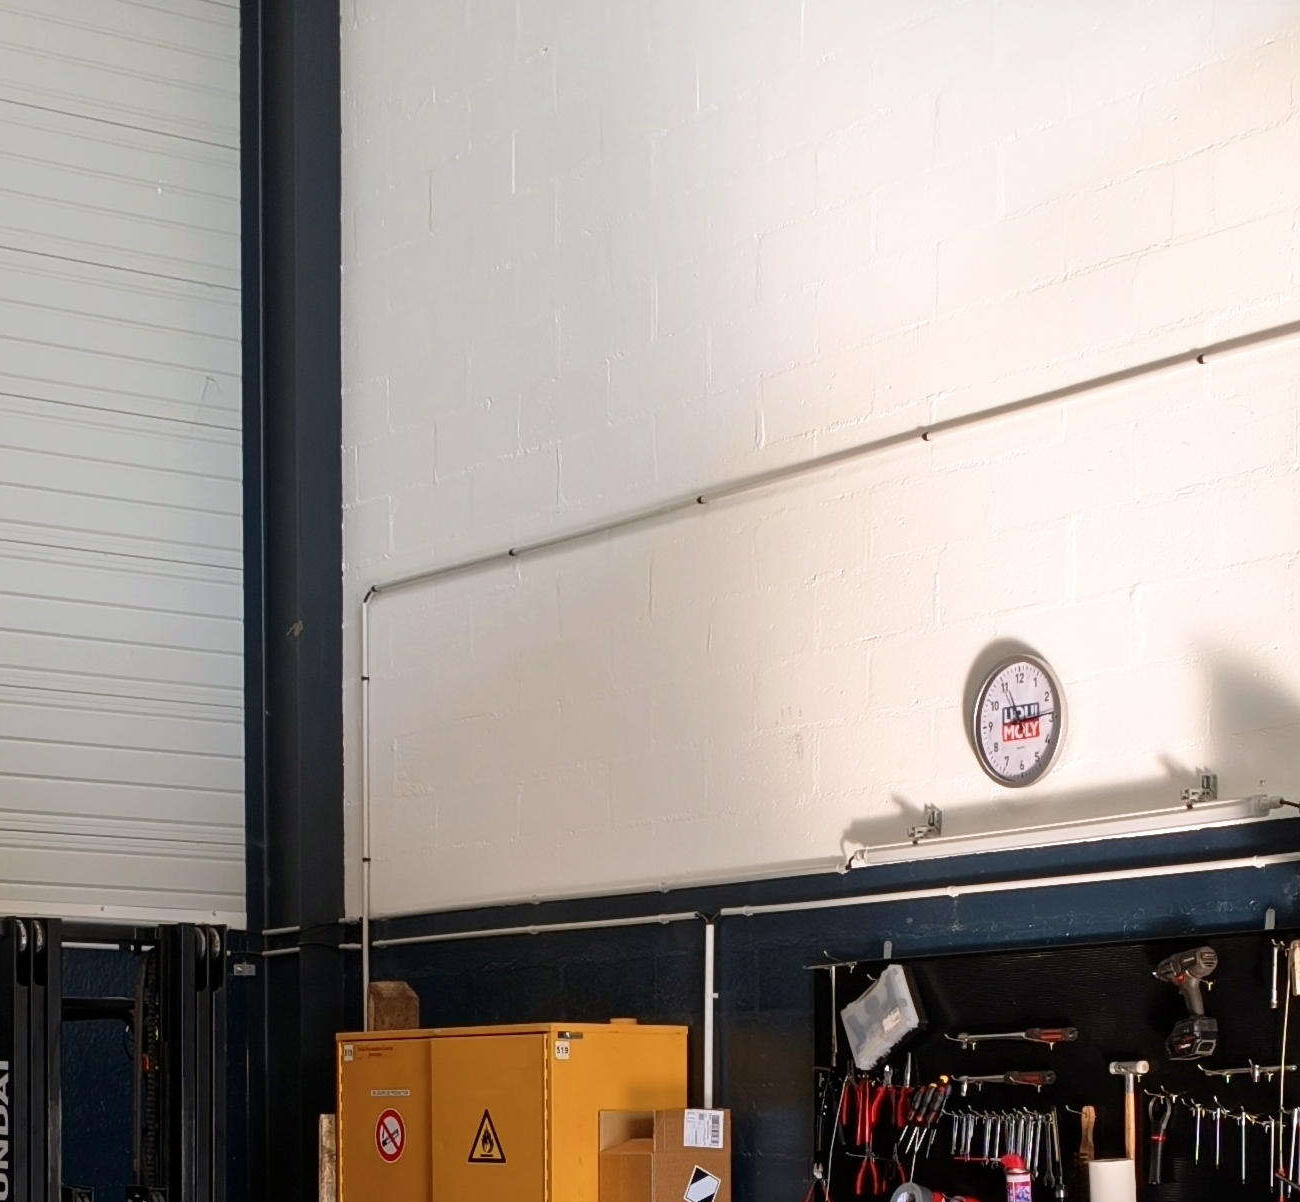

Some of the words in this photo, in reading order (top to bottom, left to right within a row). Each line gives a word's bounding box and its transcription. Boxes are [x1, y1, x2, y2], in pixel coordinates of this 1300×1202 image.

[1015, 673, 1024, 684] 12
[1034, 677, 1038, 687] 1
[1002, 682, 1009, 693] 11
[1044, 692, 1050, 702] 2
[991, 701, 1000, 712] 10
[988, 722, 994, 733] 9
[1045, 734, 1051, 744] 4
[993, 742, 999, 752] 8
[1004, 756, 1010, 767] 7
[1034, 752, 1040, 763] 5
[1020, 760, 1025, 770] 6
